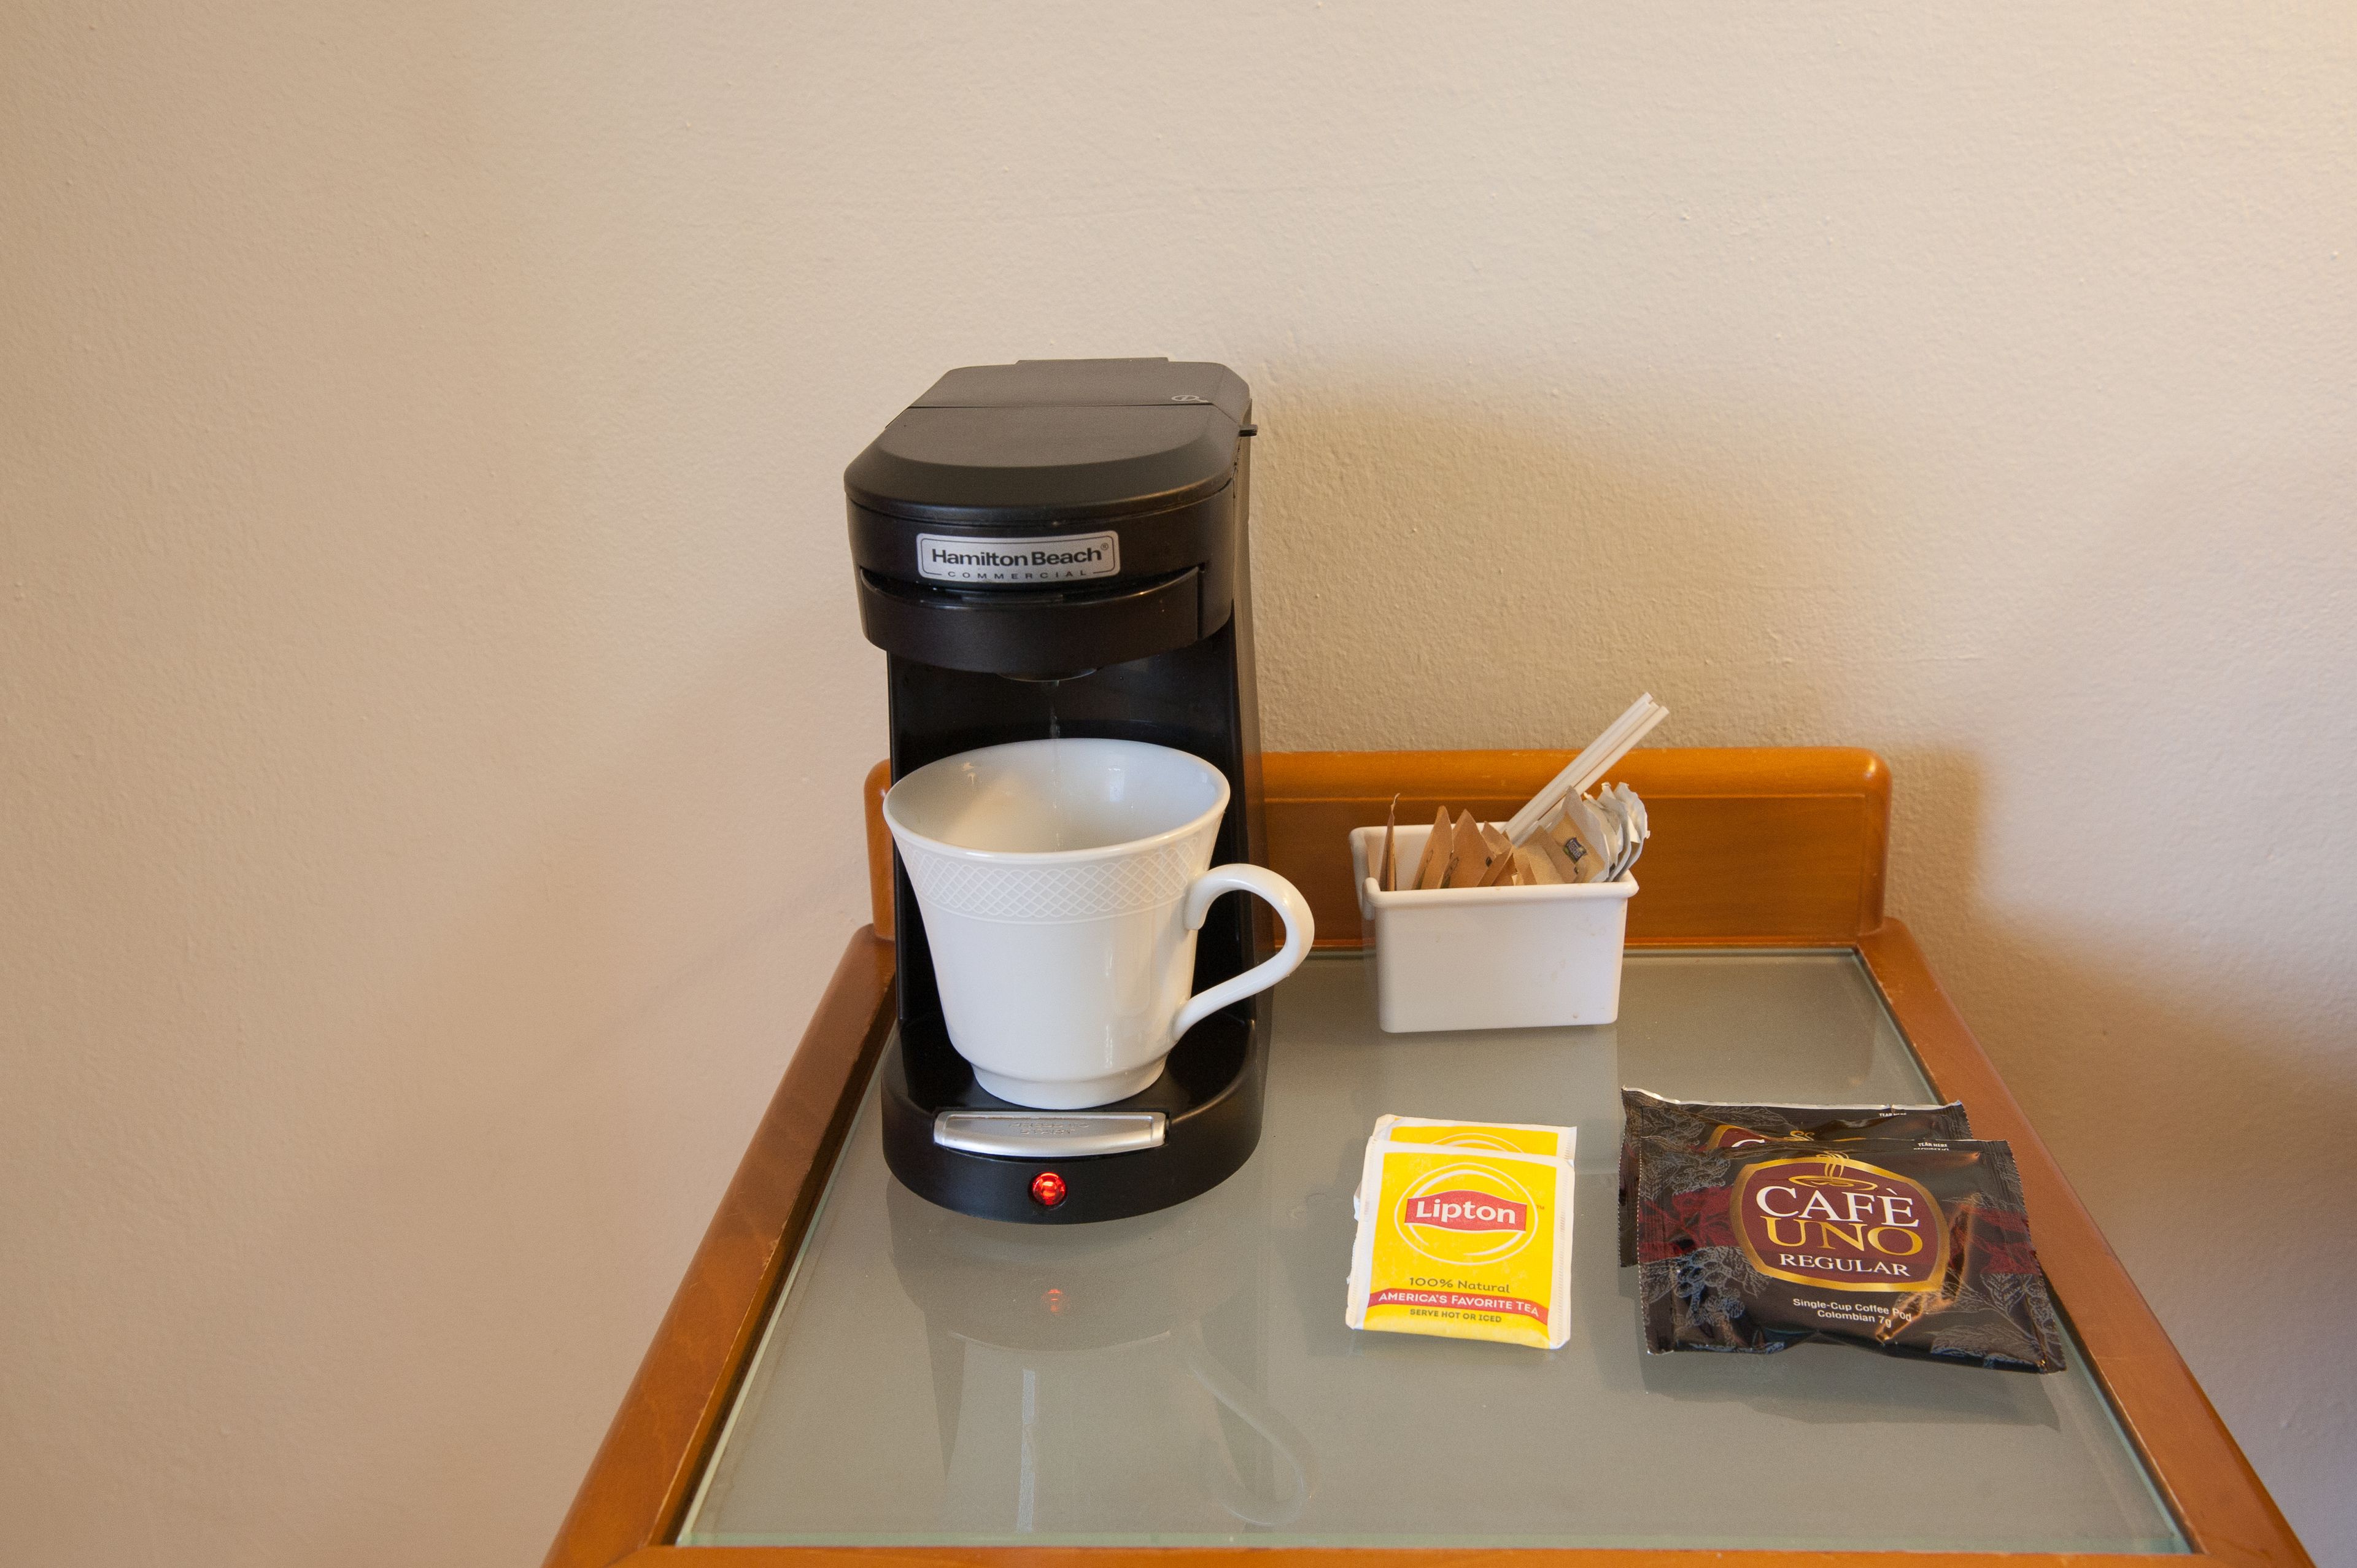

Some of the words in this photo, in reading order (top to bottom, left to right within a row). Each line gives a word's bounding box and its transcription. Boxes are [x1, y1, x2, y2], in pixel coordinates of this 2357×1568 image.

[932, 548, 1028, 566] Hamilton
[948, 570, 1087, 580] COMMERCIAL
[1415, 1199, 1516, 1224] Lipton
[1760, 1216, 1923, 1256] UNO
[1779, 1254, 1910, 1276] REGULAR
[1409, 1277, 1453, 1288] 100%
[1458, 1280, 1511, 1293] Natural
[1379, 1292, 1447, 1304] AMERICA'S
[1452, 1295, 1512, 1309] FAVORITE
[1516, 1301, 1539, 1317] TEA
[1793, 1298, 1852, 1311] Single-Cup
[1855, 1303, 1889, 1315] Coffee
[1892, 1308, 1912, 1322] Pod
[1410, 1308, 1439, 1317] SERVE
[1479, 1314, 1502, 1323] ICED
[1817, 1310, 1875, 1323] Colombian
[1878, 1316, 1892, 1328] 7g
